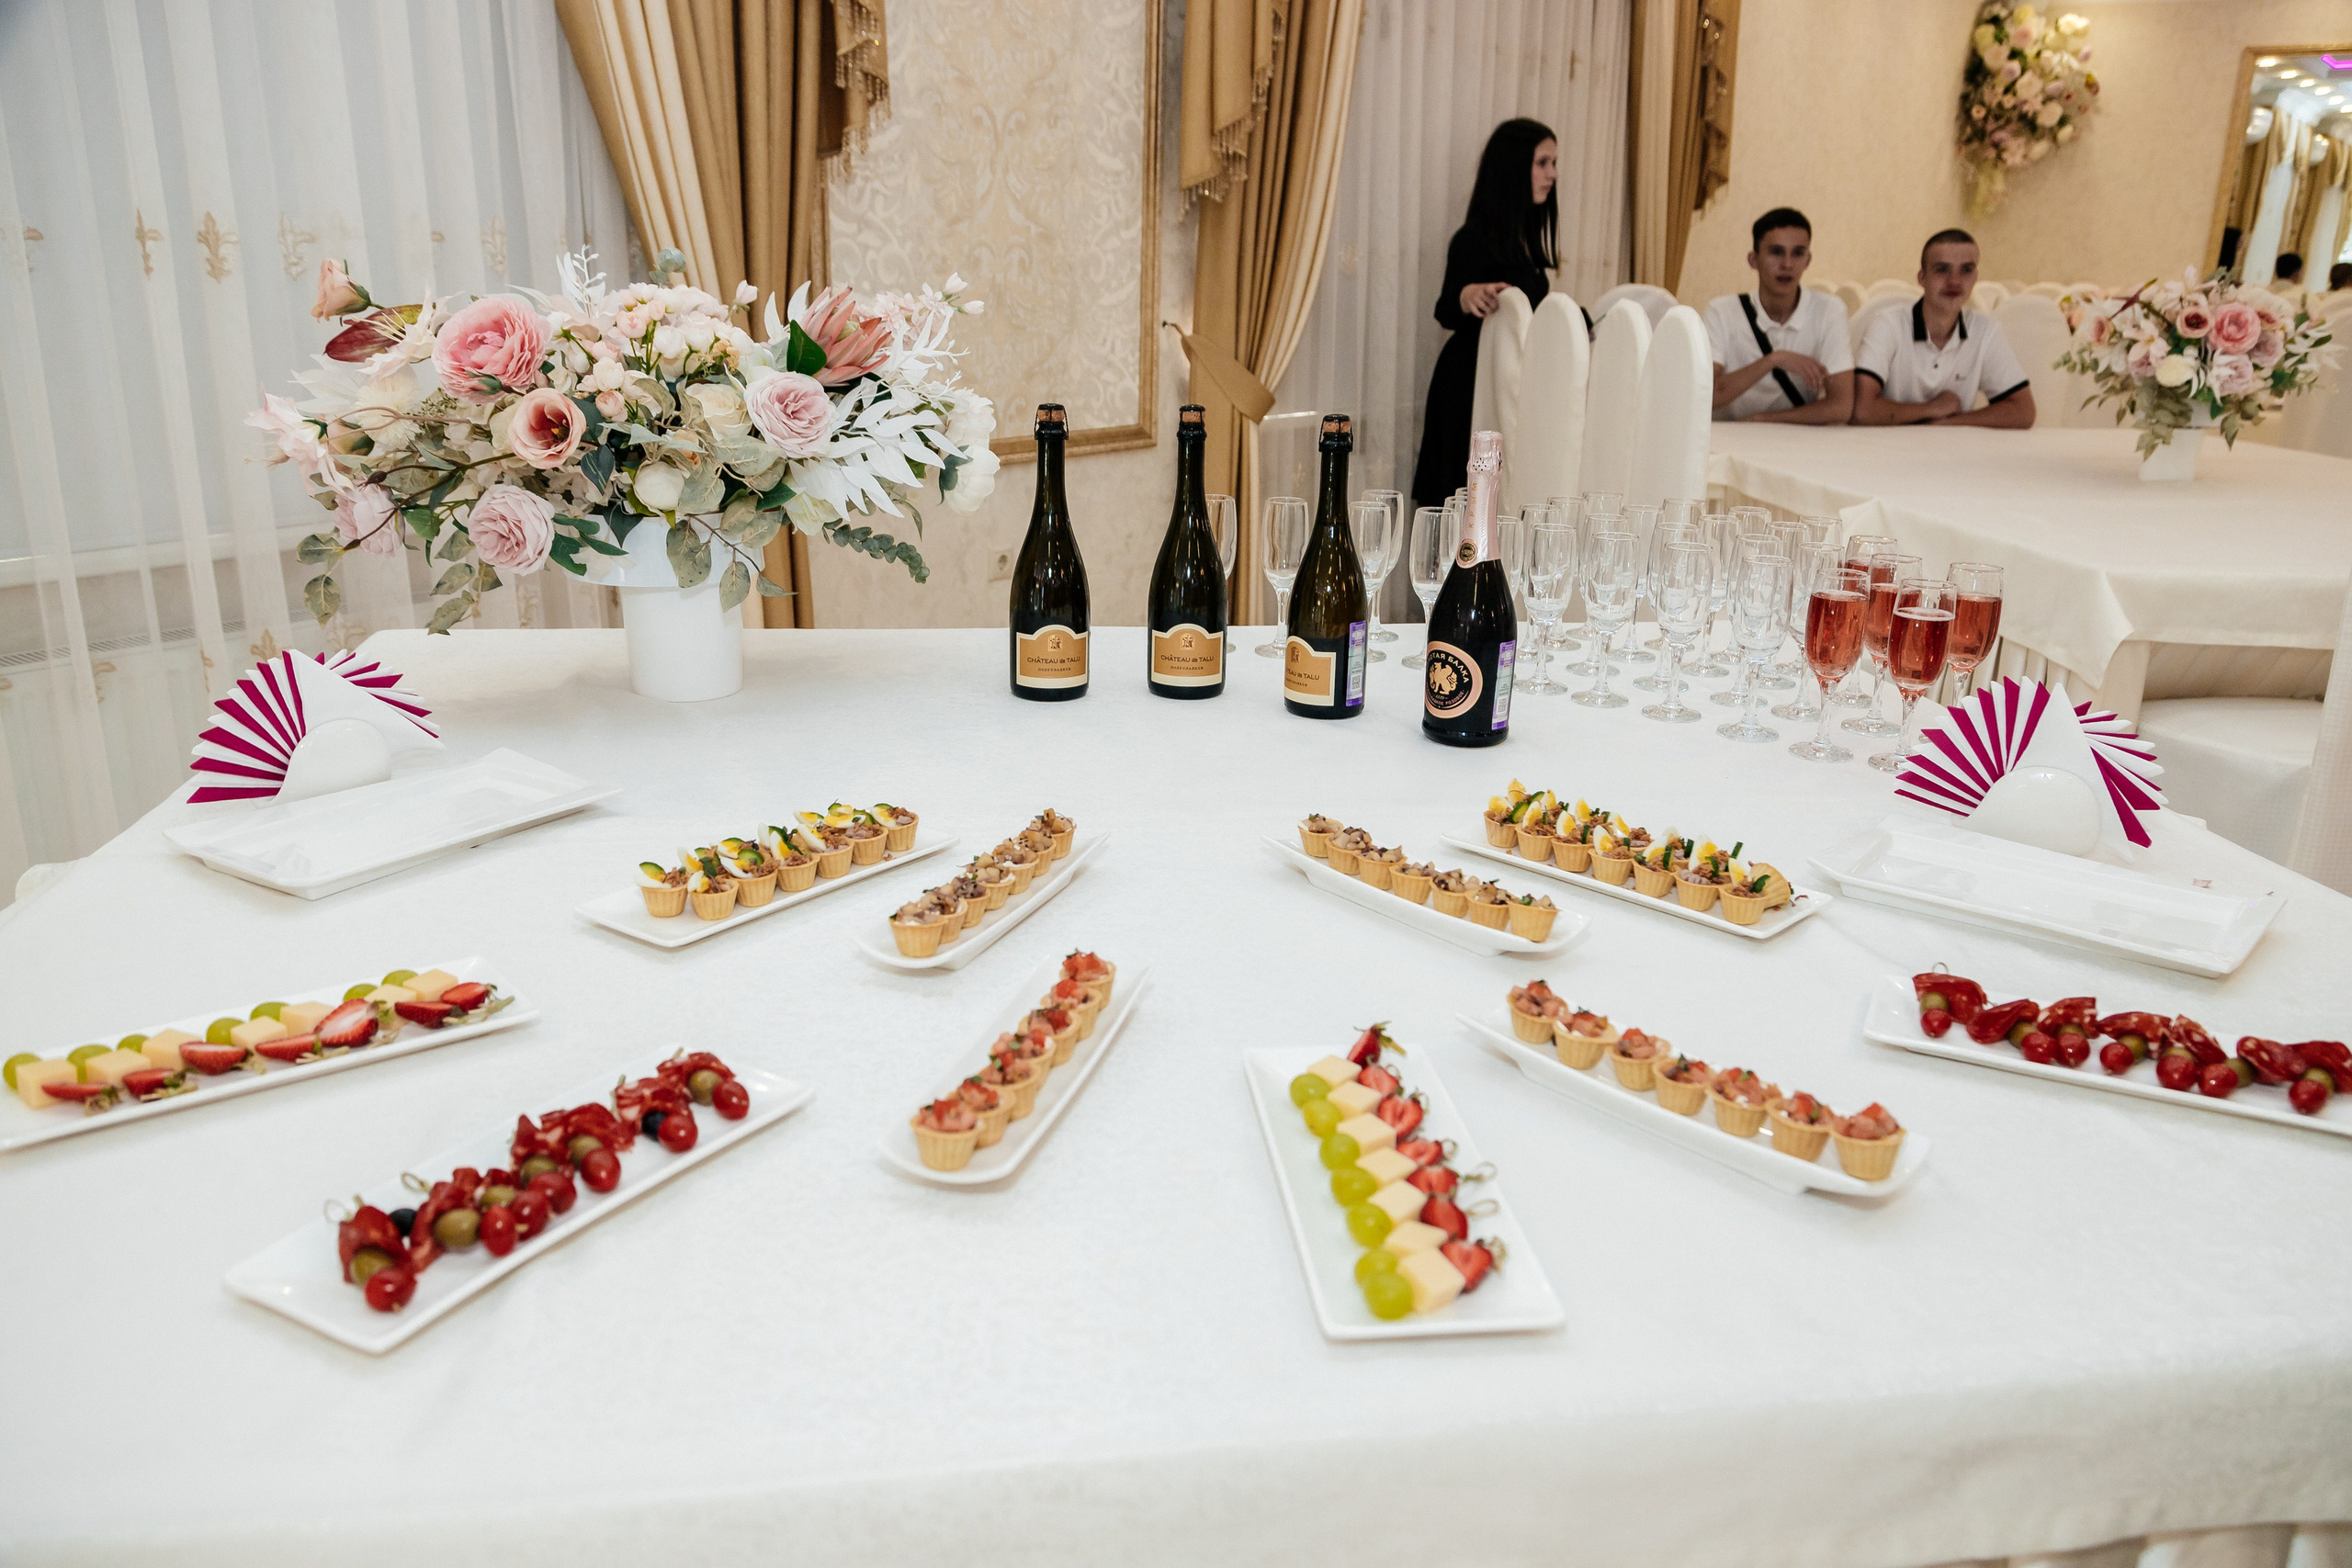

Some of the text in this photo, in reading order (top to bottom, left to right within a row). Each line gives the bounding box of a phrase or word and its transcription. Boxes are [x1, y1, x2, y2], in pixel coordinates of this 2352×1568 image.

[1026, 656, 1058, 664] CHÂTEAU
[1160, 654, 1191, 662] CHÂTEAU
[1428, 652, 1470, 683] ОТАЯ БАЛКА
[1303, 672, 1320, 681] TALU
